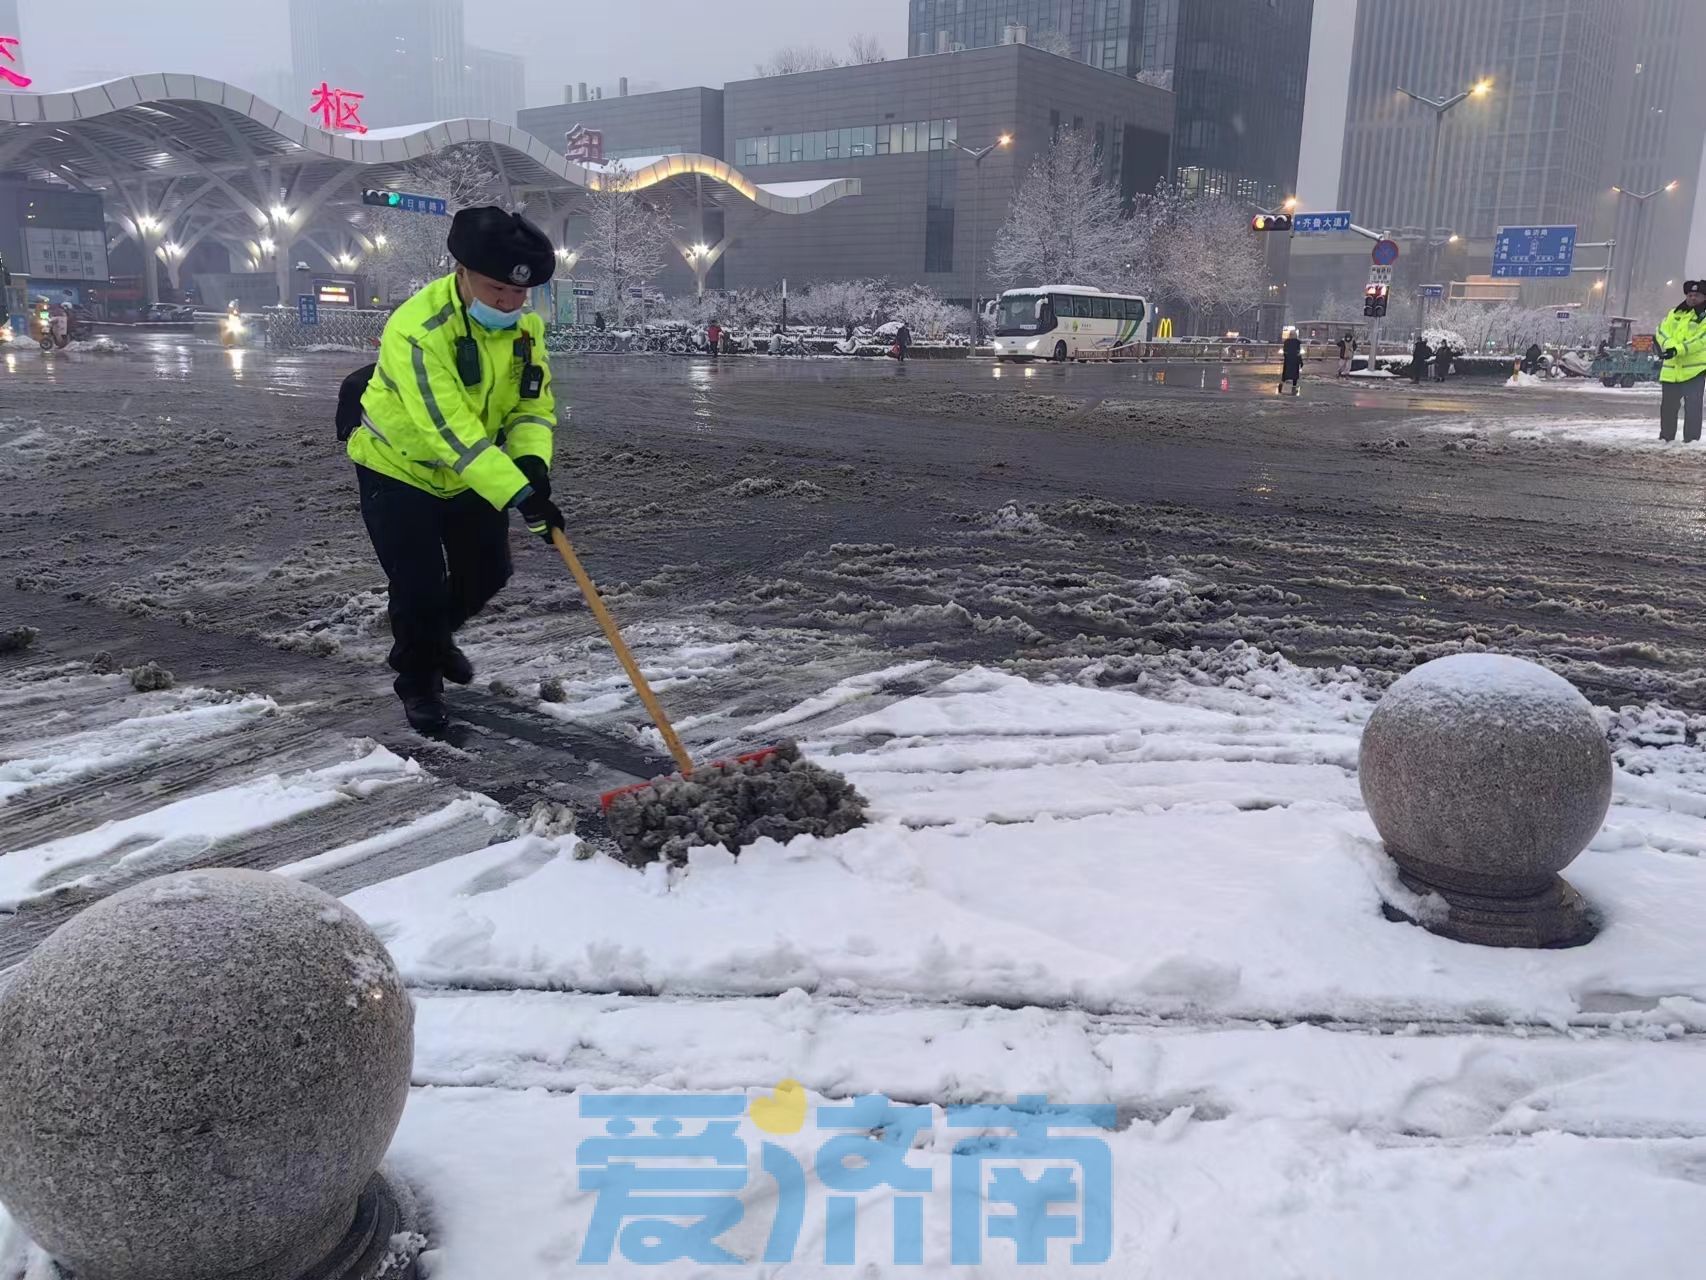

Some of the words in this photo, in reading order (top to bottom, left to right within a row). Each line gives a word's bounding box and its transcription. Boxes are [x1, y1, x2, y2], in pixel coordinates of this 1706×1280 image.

[309, 82, 368, 135] 枢
[1302, 217, 1343, 229] 齐鲁大道
